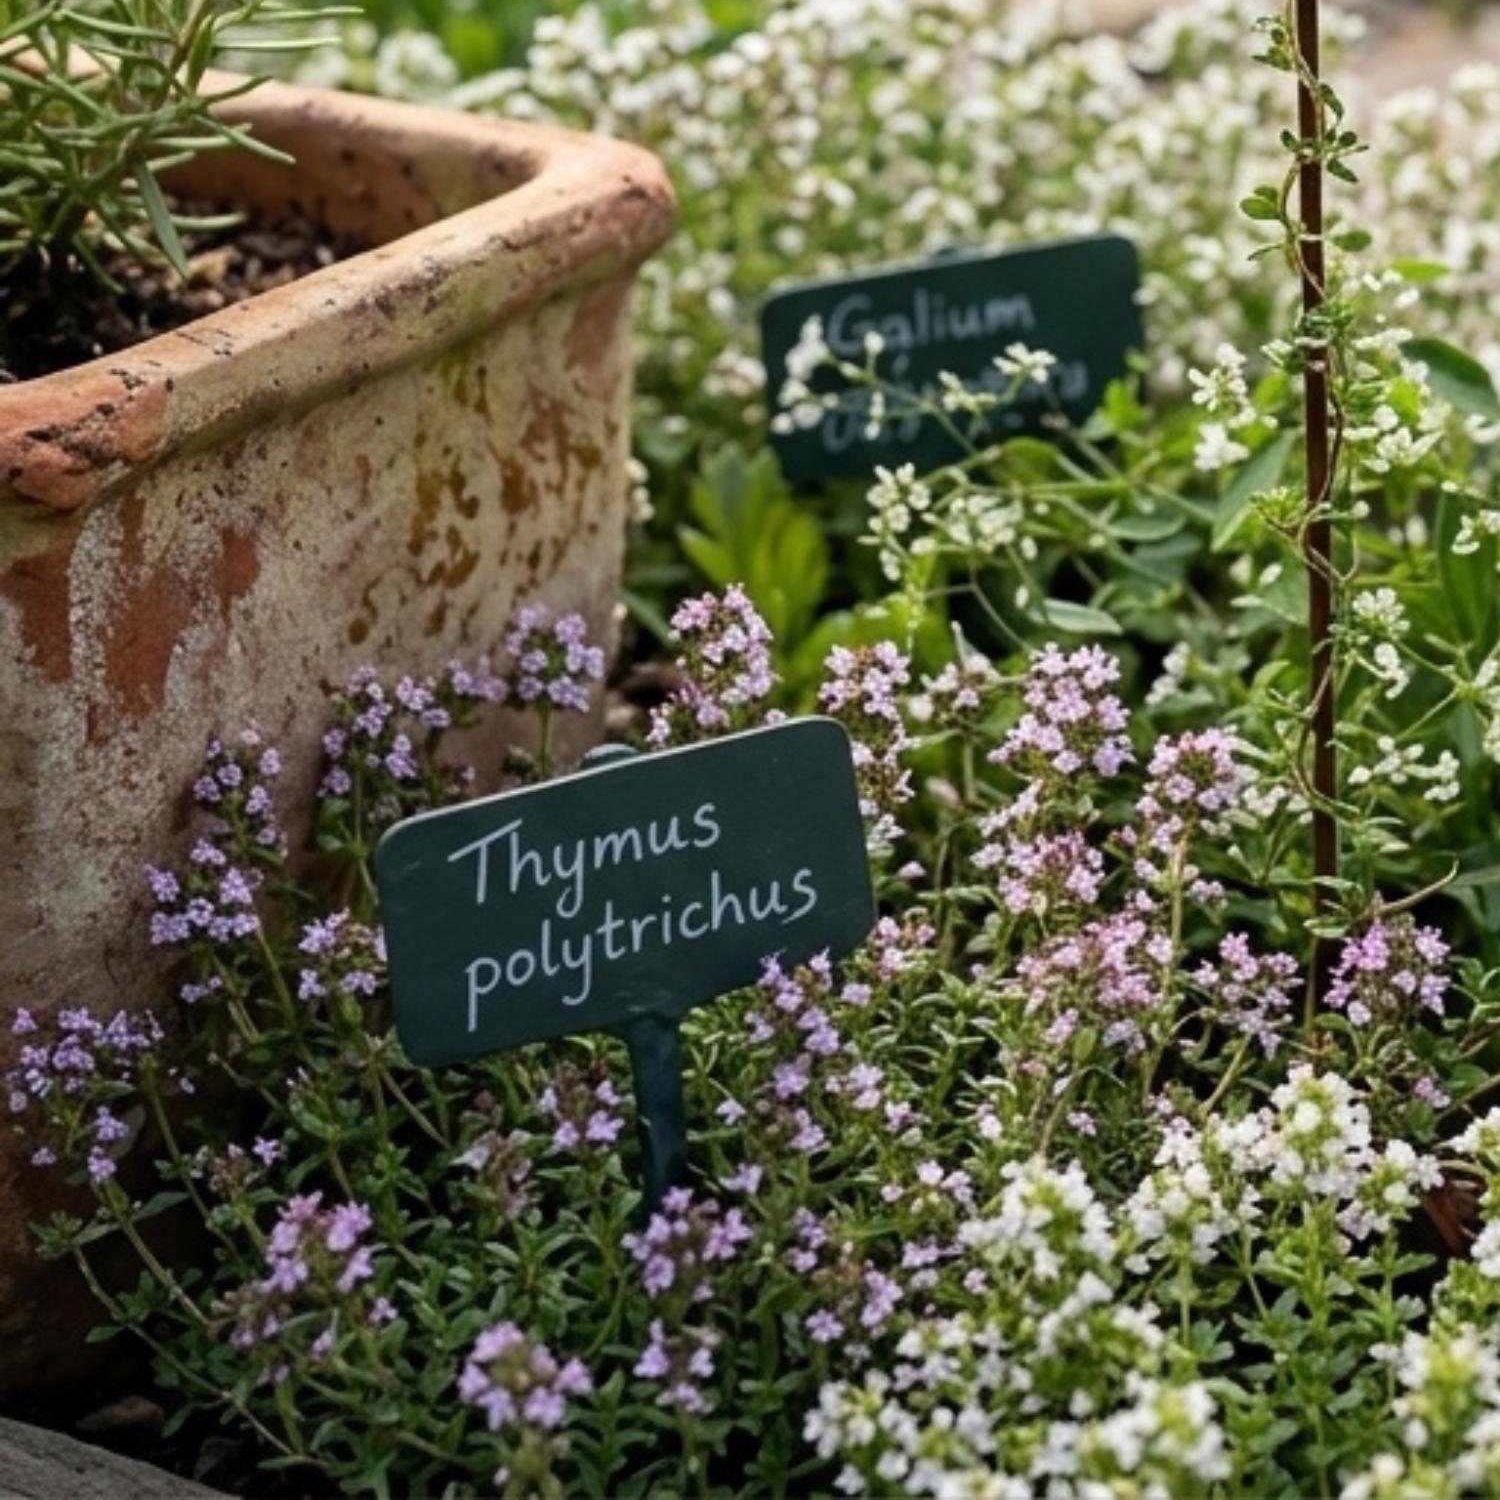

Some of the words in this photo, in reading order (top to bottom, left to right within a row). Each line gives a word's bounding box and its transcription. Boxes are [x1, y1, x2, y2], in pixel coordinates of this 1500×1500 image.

[827, 287, 1036, 356] Galium
[447, 802, 721, 919] Thymus
[464, 867, 819, 1032] polytrichus
